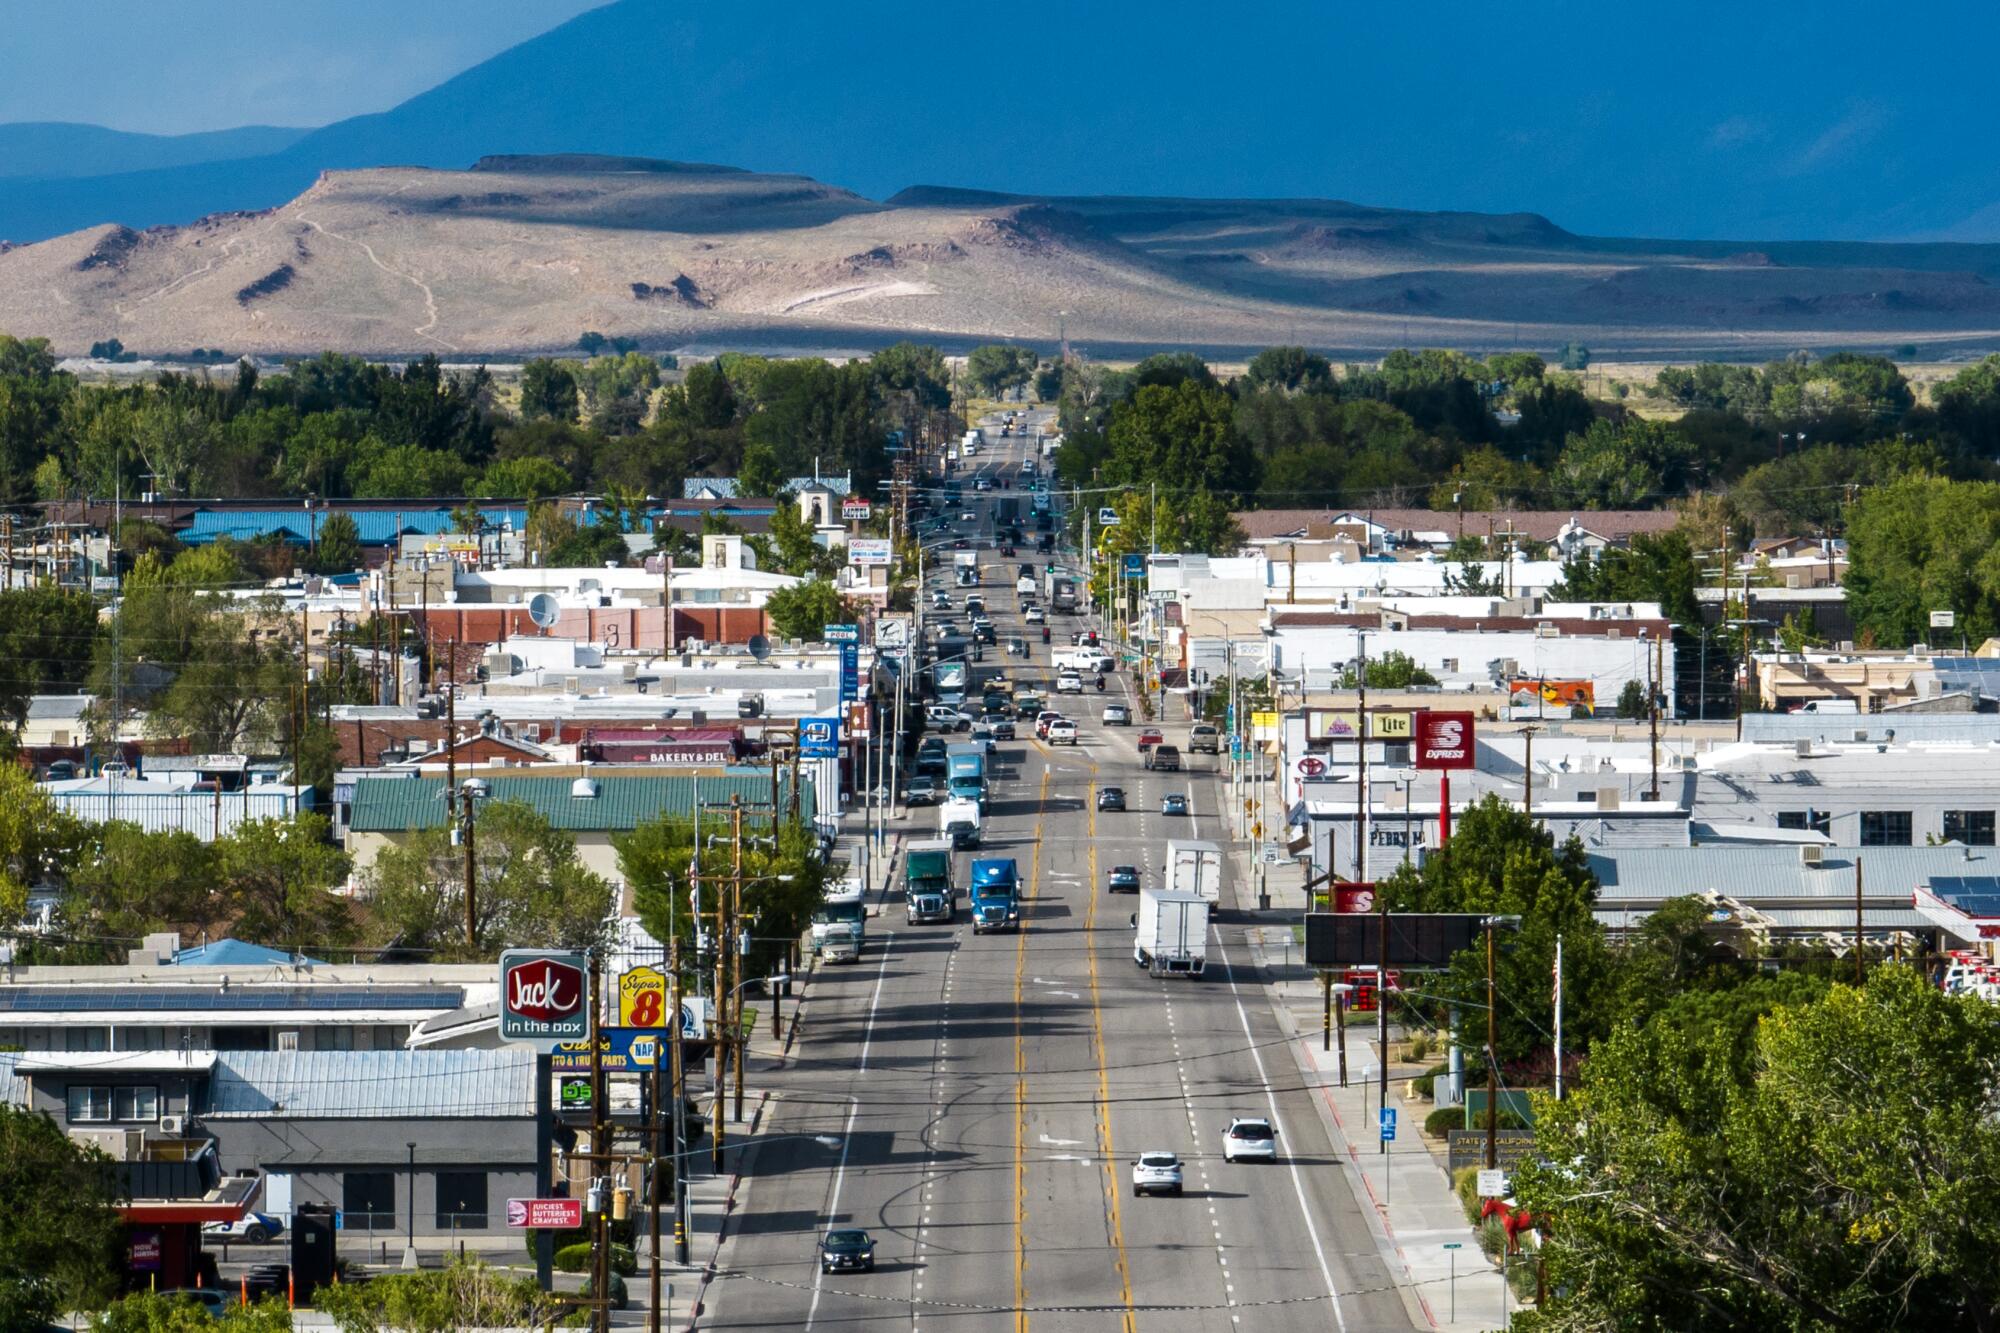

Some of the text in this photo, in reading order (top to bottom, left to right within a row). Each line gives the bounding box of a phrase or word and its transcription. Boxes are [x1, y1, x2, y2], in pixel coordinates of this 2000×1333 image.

[1380, 715, 1406, 733] Lite
[650, 752, 727, 761] BAKERY & DEL
[1425, 749, 1465, 759] EXPRESS
[1370, 831, 1407, 847] PERRY
[510, 967, 578, 1011] Jack
[622, 974, 662, 996] Super
[628, 990, 662, 1027] 8
[507, 1020, 521, 1032] in
[524, 1020, 549, 1032] the
[567, 1055, 574, 1067] &
[575, 1055, 591, 1067] TRU
[602, 1055, 627, 1066] PARTS
[1456, 1137, 1479, 1145] STATE
